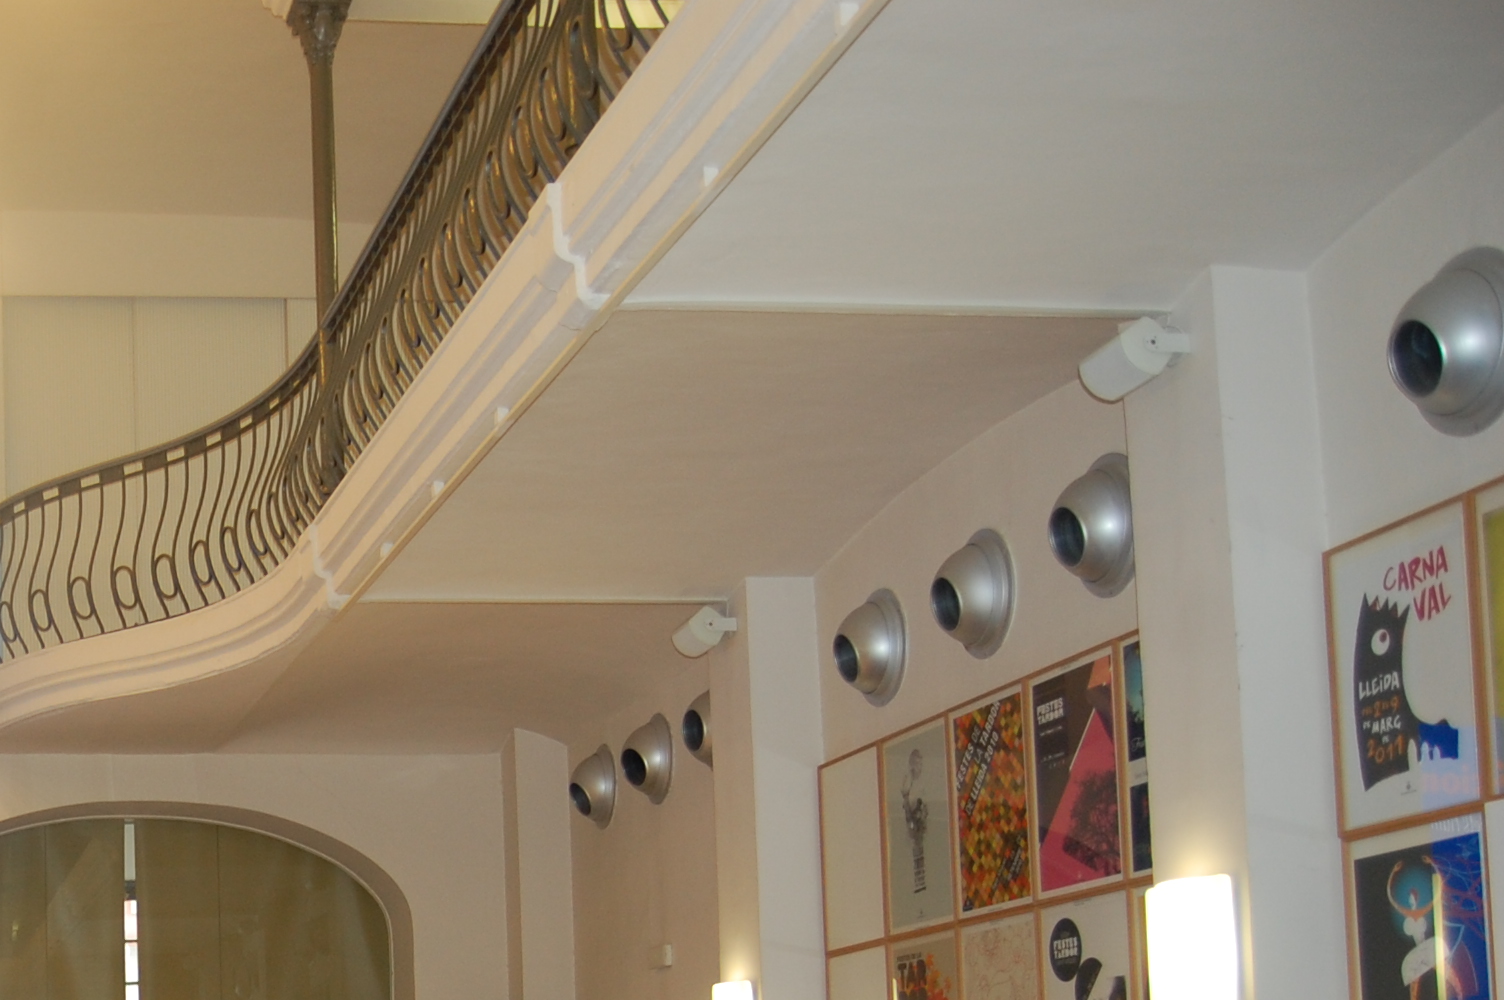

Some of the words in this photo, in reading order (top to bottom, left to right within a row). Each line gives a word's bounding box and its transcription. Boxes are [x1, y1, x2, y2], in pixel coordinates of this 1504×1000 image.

[1383, 545, 1448, 591] CARNA
[1413, 582, 1451, 621] VAL
[979, 700, 1000, 746] TARDOR
[984, 731, 999, 762] 2010
[1367, 733, 1406, 764] 2011
